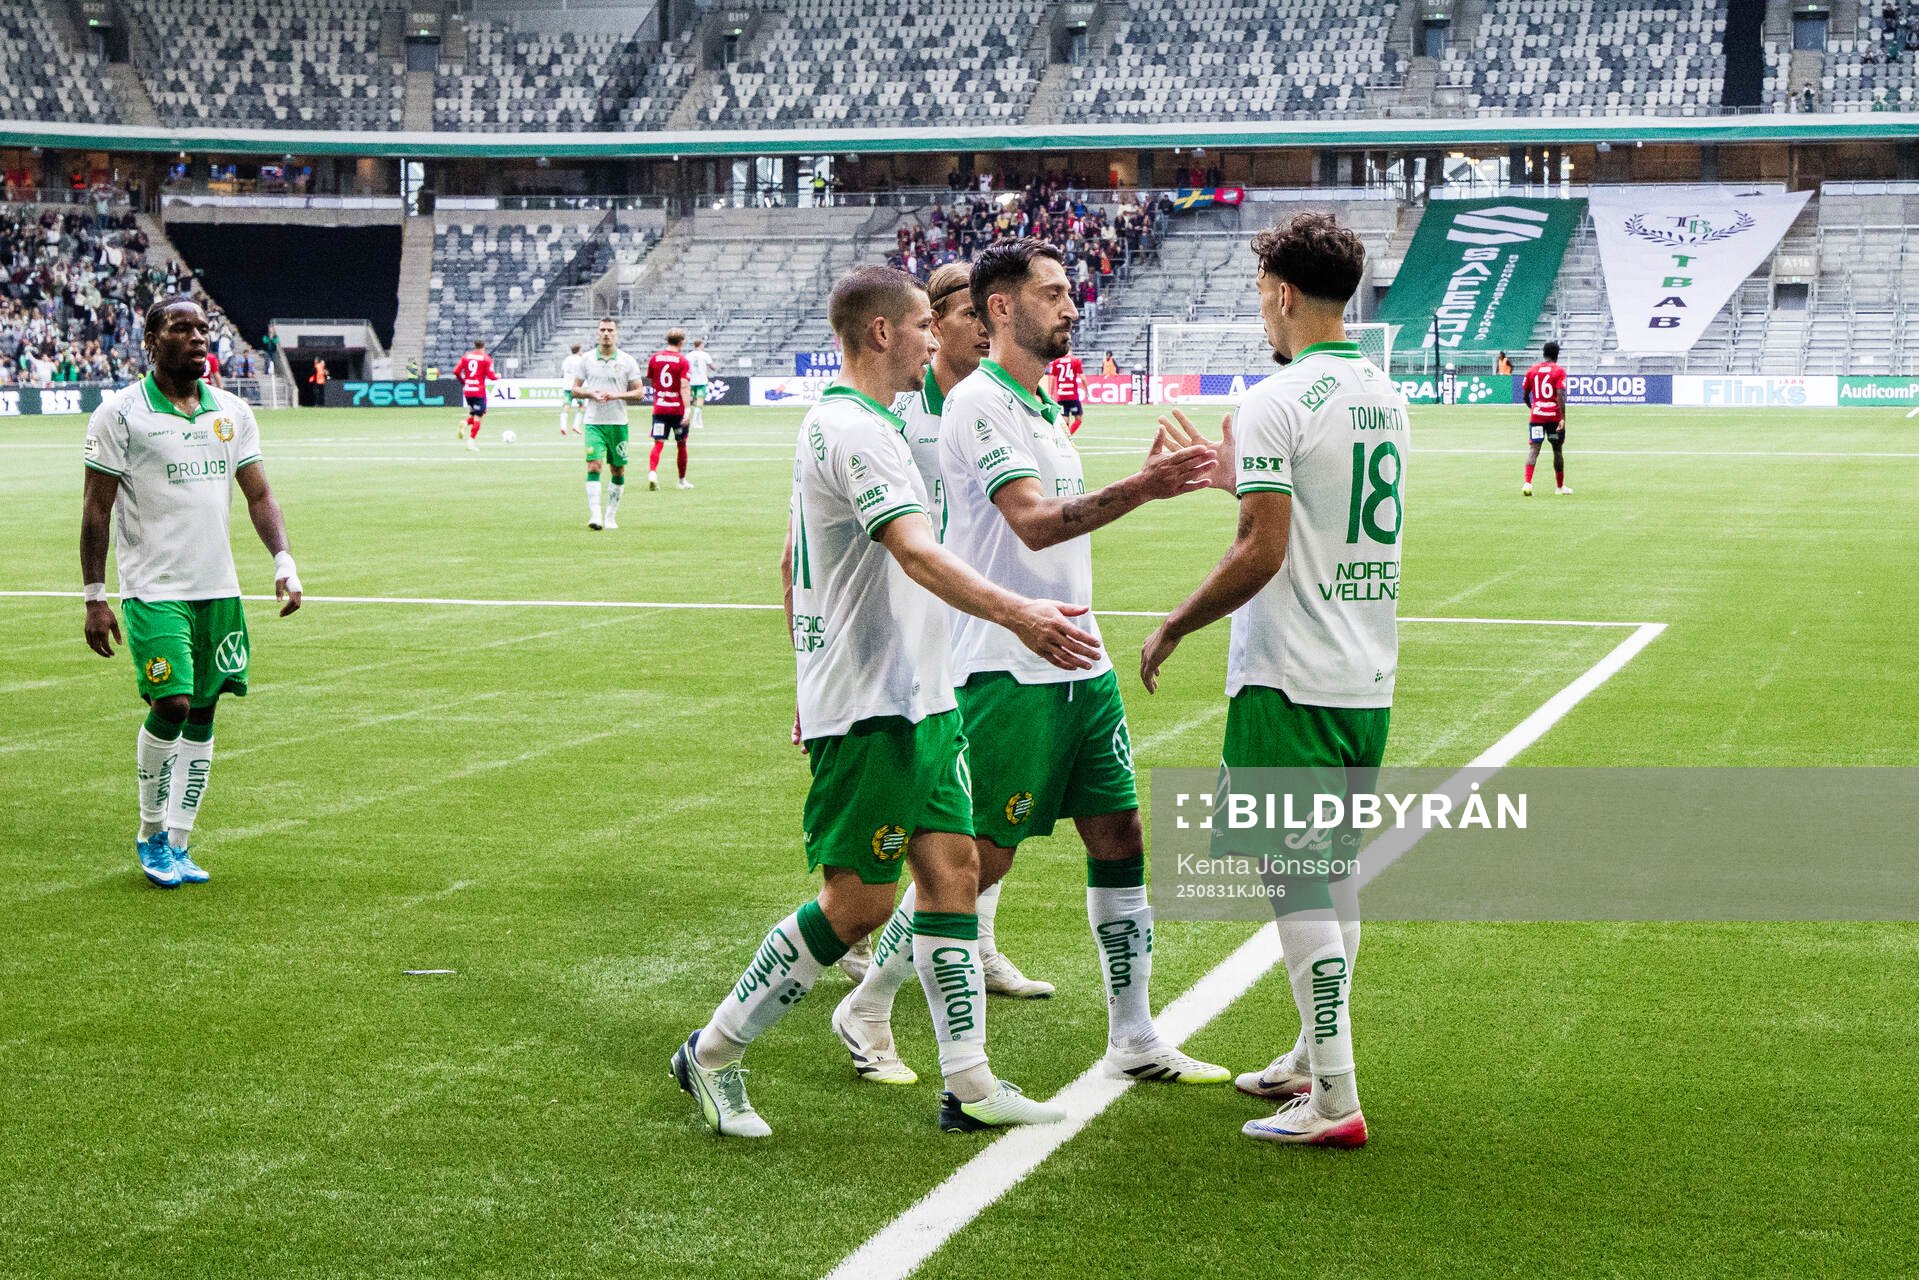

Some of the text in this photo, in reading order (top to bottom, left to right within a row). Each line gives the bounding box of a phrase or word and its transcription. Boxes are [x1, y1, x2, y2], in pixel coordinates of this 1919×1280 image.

[467, 359, 479, 378] 9
[660, 363, 674, 388] 6
[1056, 362, 1075, 382] 24
[1298, 372, 1336, 409] RYDS
[1533, 374, 1554, 399] 16
[1566, 377, 1646, 395] PROJOB
[1703, 379, 1808, 404] Flinks
[1840, 383, 1919, 399] AudicomP
[1349, 406, 1403, 431] TOUNEKTI
[977, 446, 1013, 469] UNIBET
[1243, 456, 1284, 471] BST
[166, 460, 226, 479] PROJOB
[856, 483, 889, 507] NIBET
[1346, 441, 1402, 545] 18
[1336, 561, 1399, 581] NORD
[1318, 582, 1399, 602] WELLN
